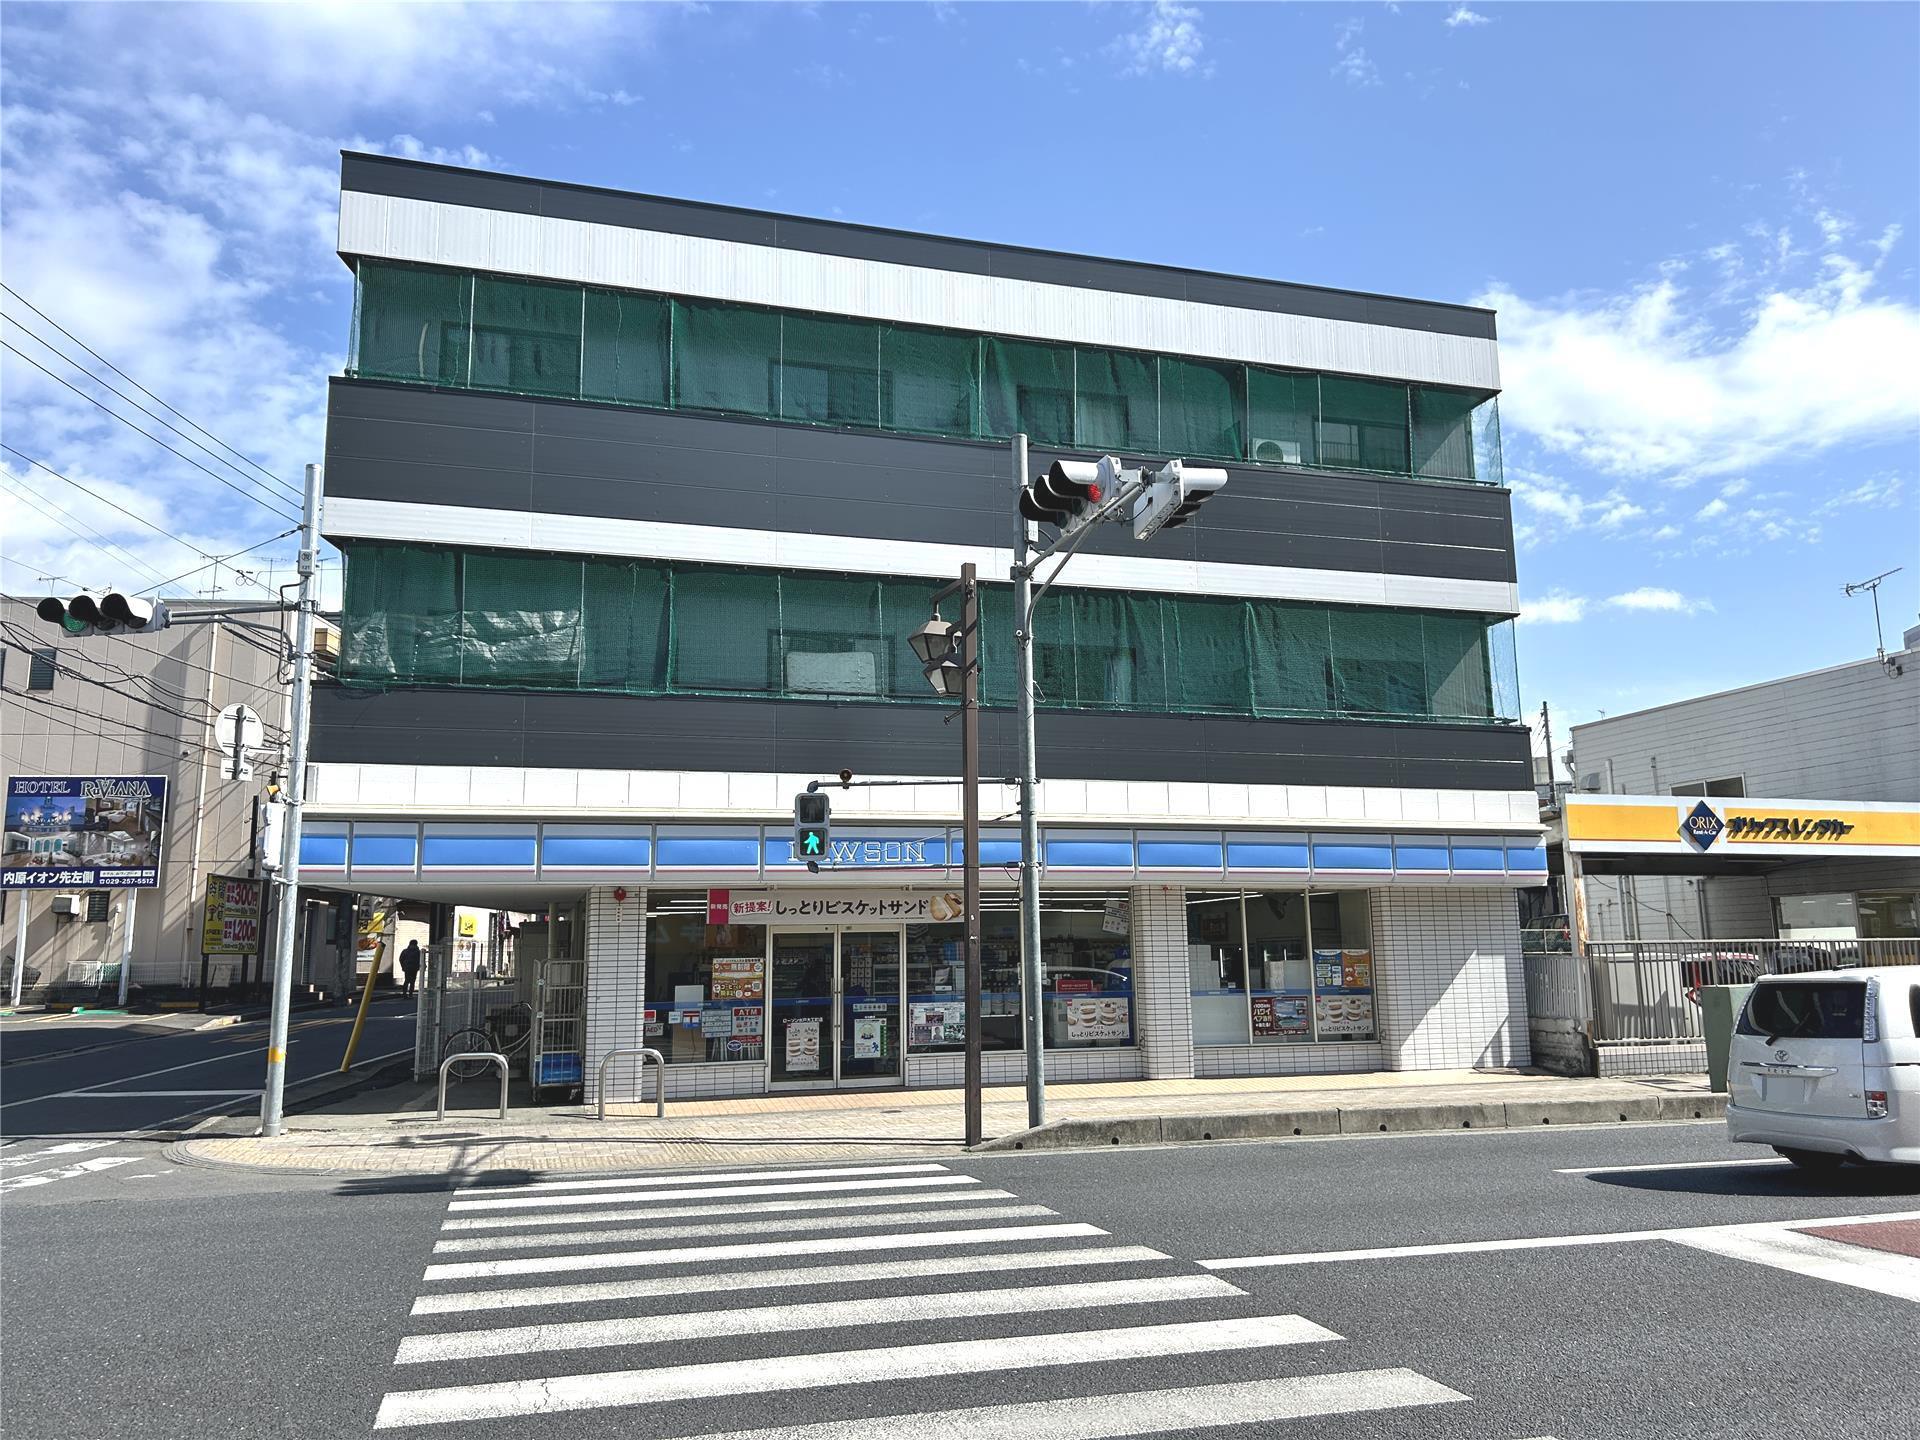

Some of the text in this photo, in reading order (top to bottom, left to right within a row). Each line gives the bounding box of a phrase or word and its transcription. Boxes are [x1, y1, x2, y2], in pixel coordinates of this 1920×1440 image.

[14, 781, 71, 794] HOTEL
[1689, 816, 1718, 829] ORIX
[1725, 816, 1855, 836] オリックスレンタカー
[787, 840, 927, 864] LWSON
[2, 871, 95, 885] 内原イオン先左側
[733, 901, 772, 914] 新提案!
[775, 899, 929, 916] しっとりビスケットサンド
